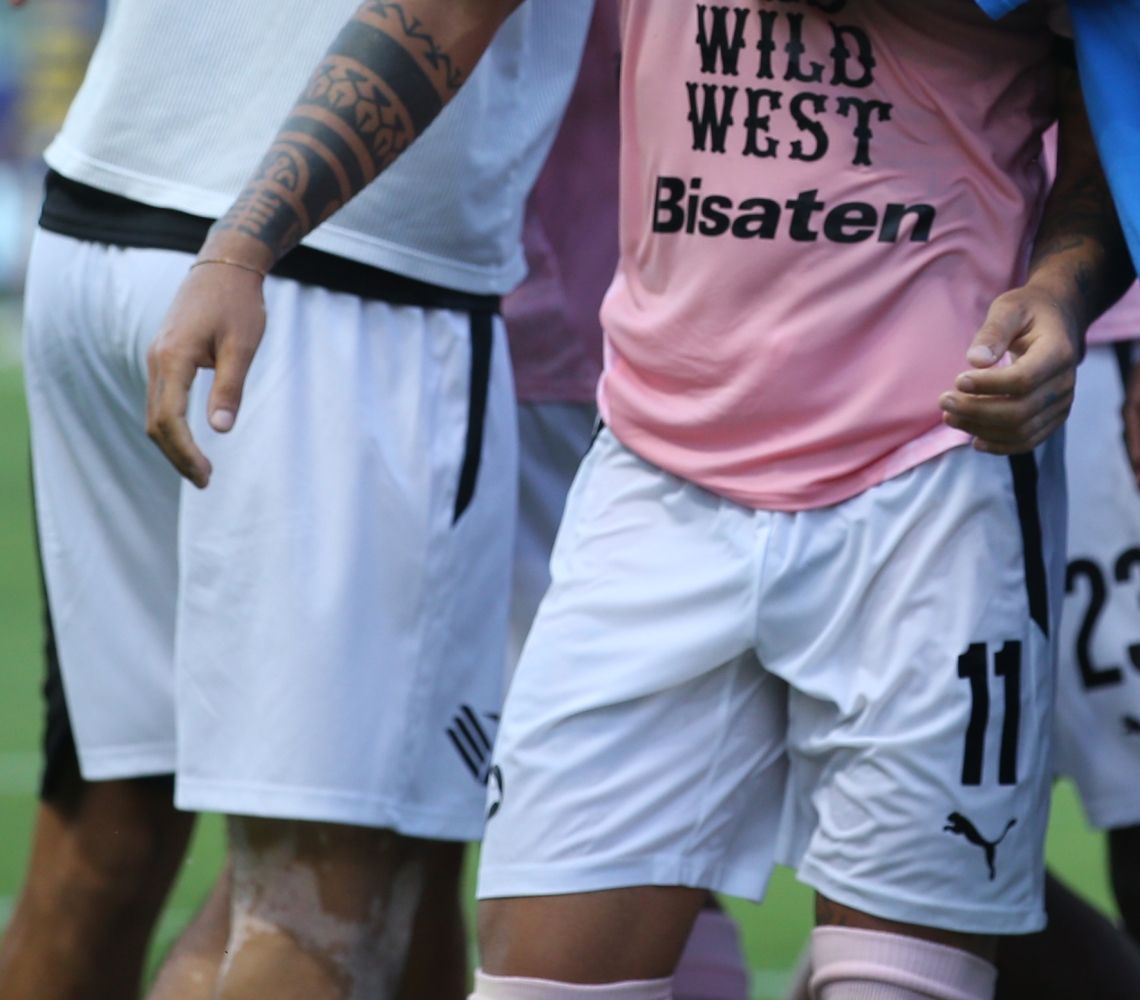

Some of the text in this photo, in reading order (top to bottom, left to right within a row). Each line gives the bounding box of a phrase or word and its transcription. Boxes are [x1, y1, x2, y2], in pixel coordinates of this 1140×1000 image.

[695, 3, 876, 88] WILD
[685, 81, 894, 166] WEST
[652, 176, 937, 243] Bisaten
[957, 640, 1022, 786] 11
